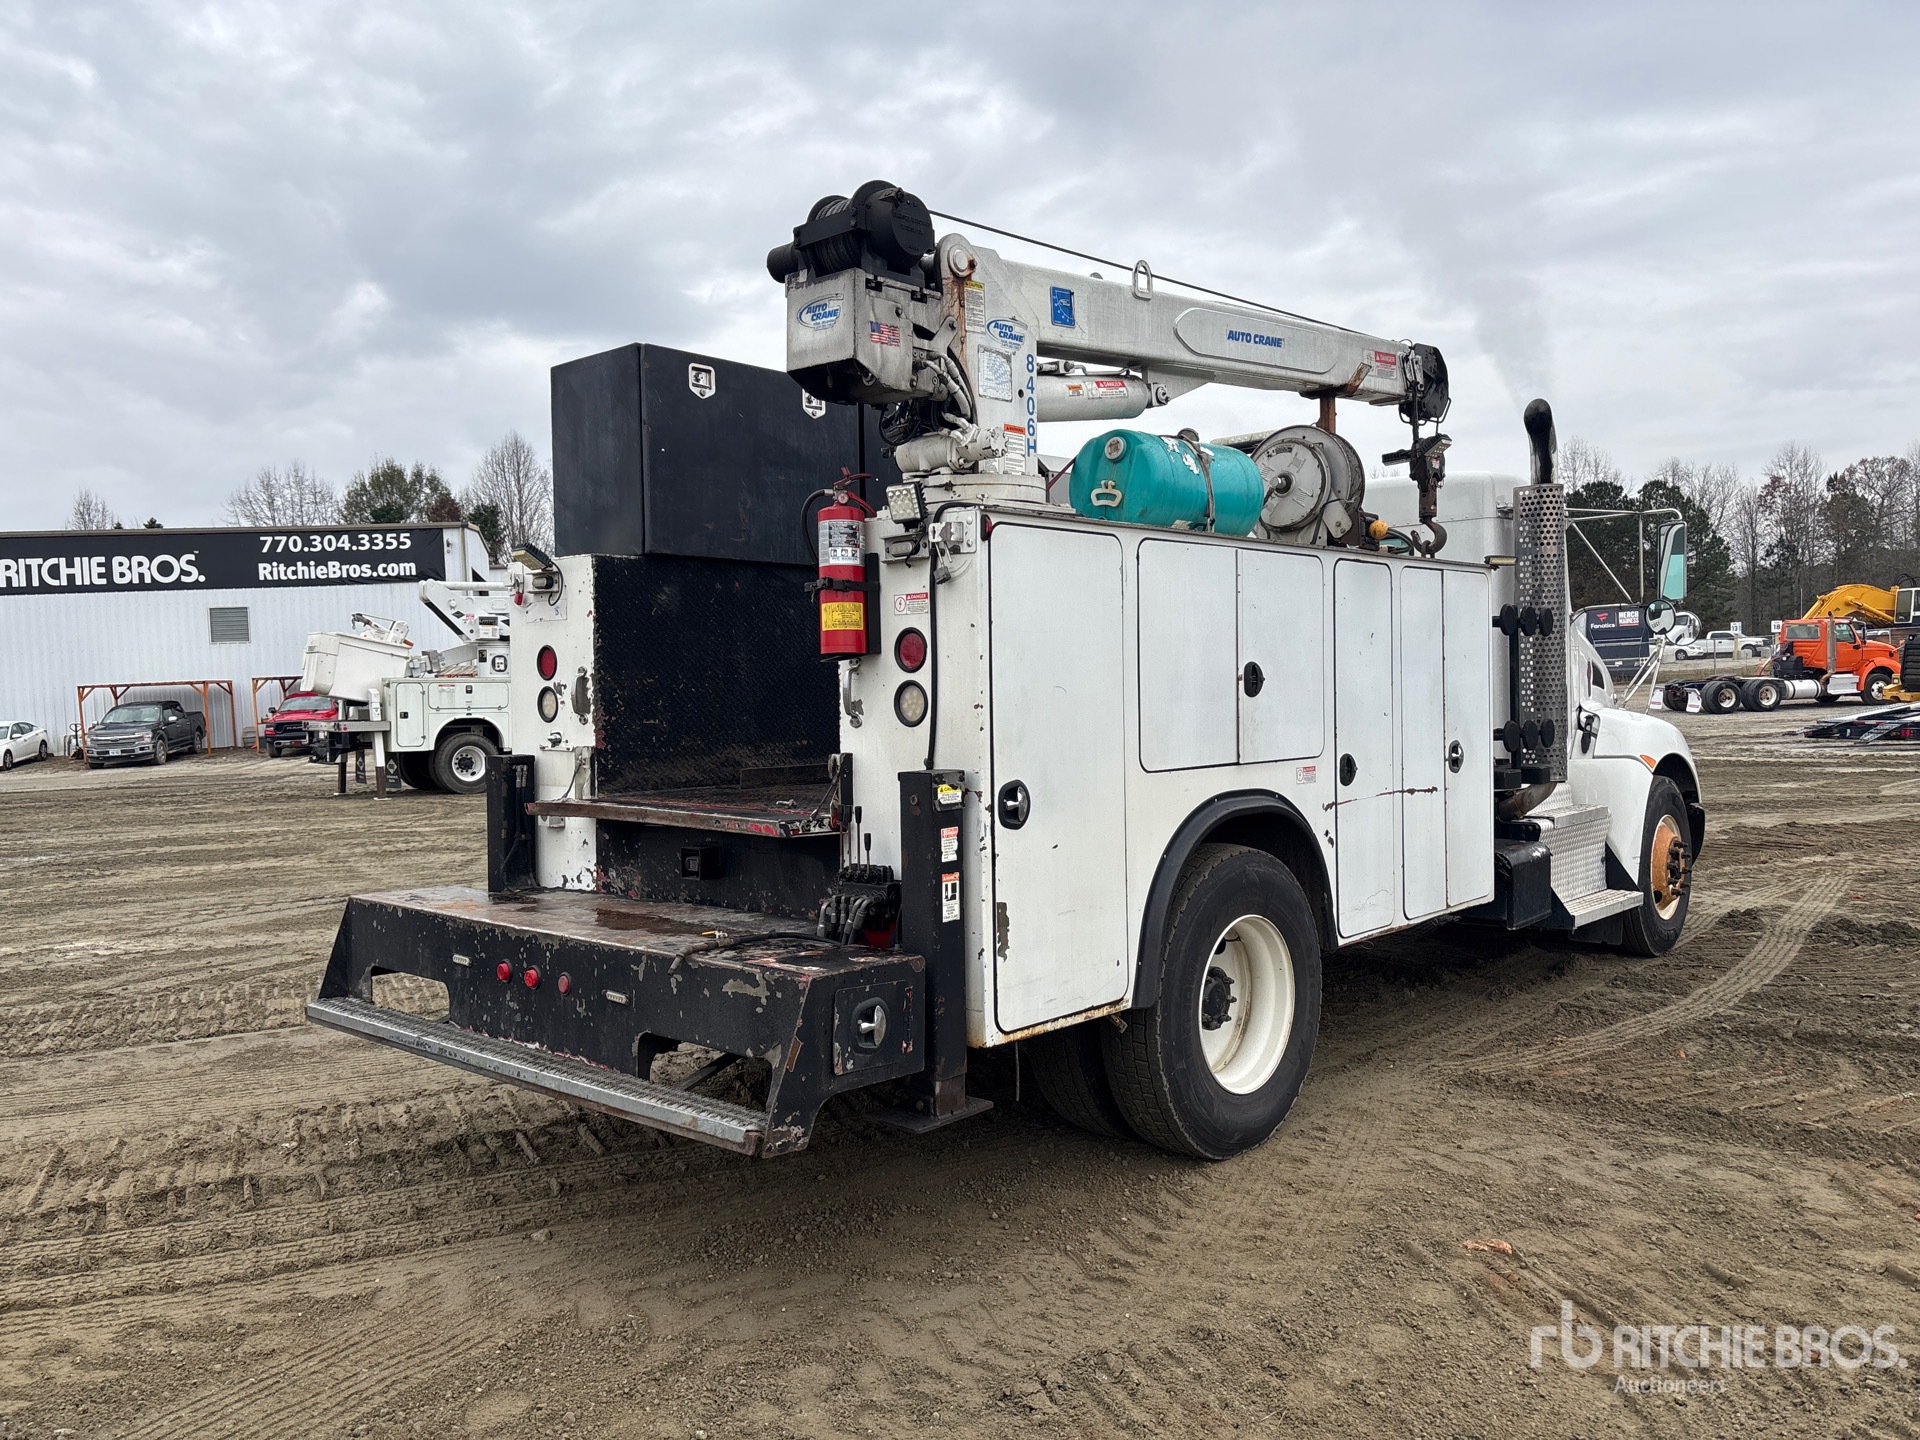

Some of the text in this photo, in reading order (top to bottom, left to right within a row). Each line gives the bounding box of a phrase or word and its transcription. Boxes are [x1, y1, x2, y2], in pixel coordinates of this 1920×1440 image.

[806, 302, 828, 314] AUTO
[811, 308, 840, 321] CRANE
[993, 321, 1014, 333] AUTO
[998, 330, 1025, 343] CRANE
[1227, 330, 1283, 348] AUTO CRANE
[1026, 353, 1037, 457] 8406H
[259, 532, 412, 554] 770.304.3355
[0, 553, 206, 588] RITCHIE BROS.
[258, 560, 417, 581] RitchieBros.com
[1618, 610, 1639, 618] MERCH
